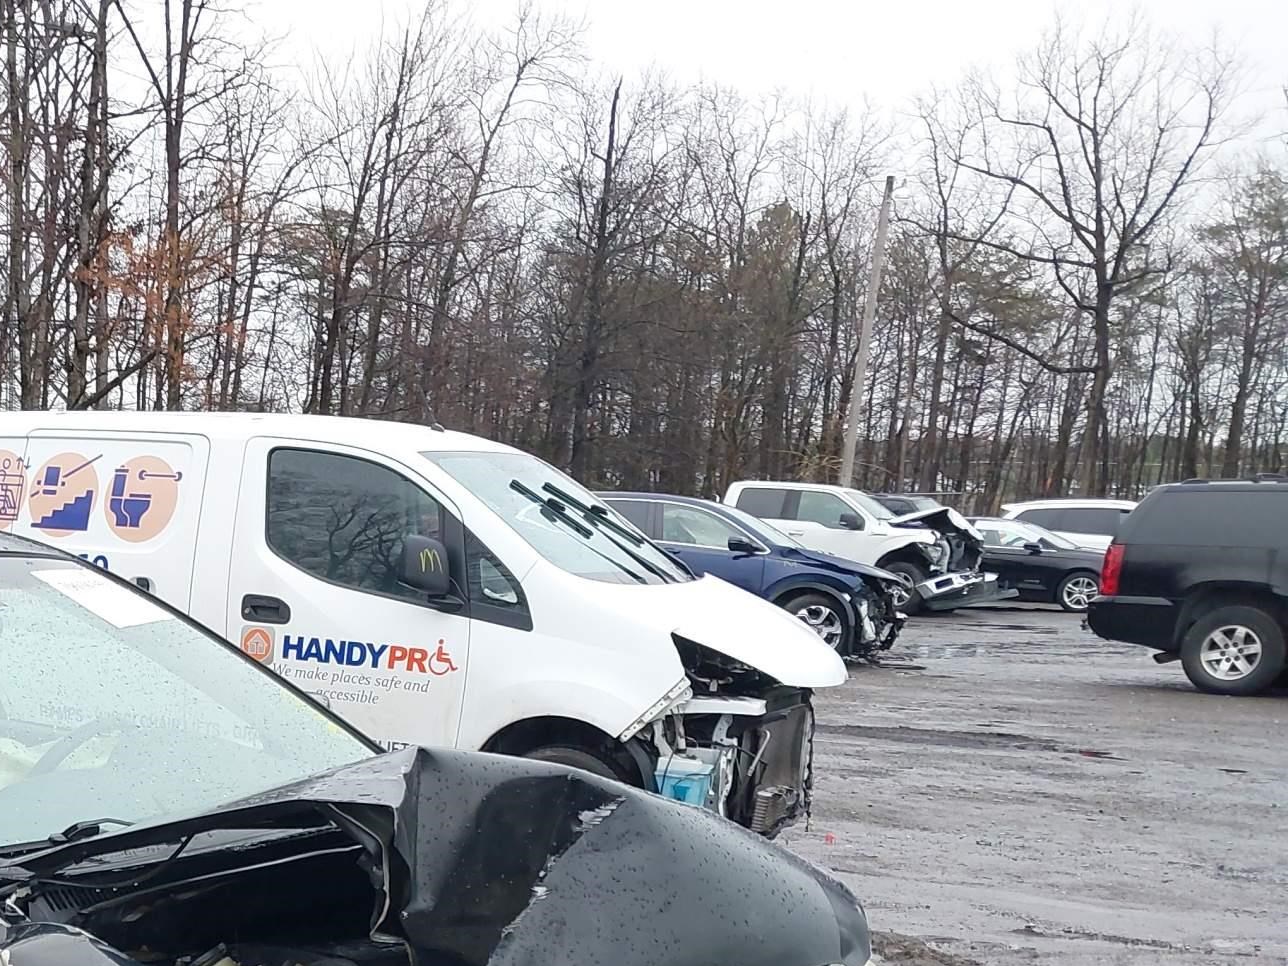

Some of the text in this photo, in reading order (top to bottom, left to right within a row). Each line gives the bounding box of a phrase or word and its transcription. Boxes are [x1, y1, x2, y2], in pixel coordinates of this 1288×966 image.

[272, 663, 431, 693] We make places safe and
[315, 687, 379, 704] accessible
